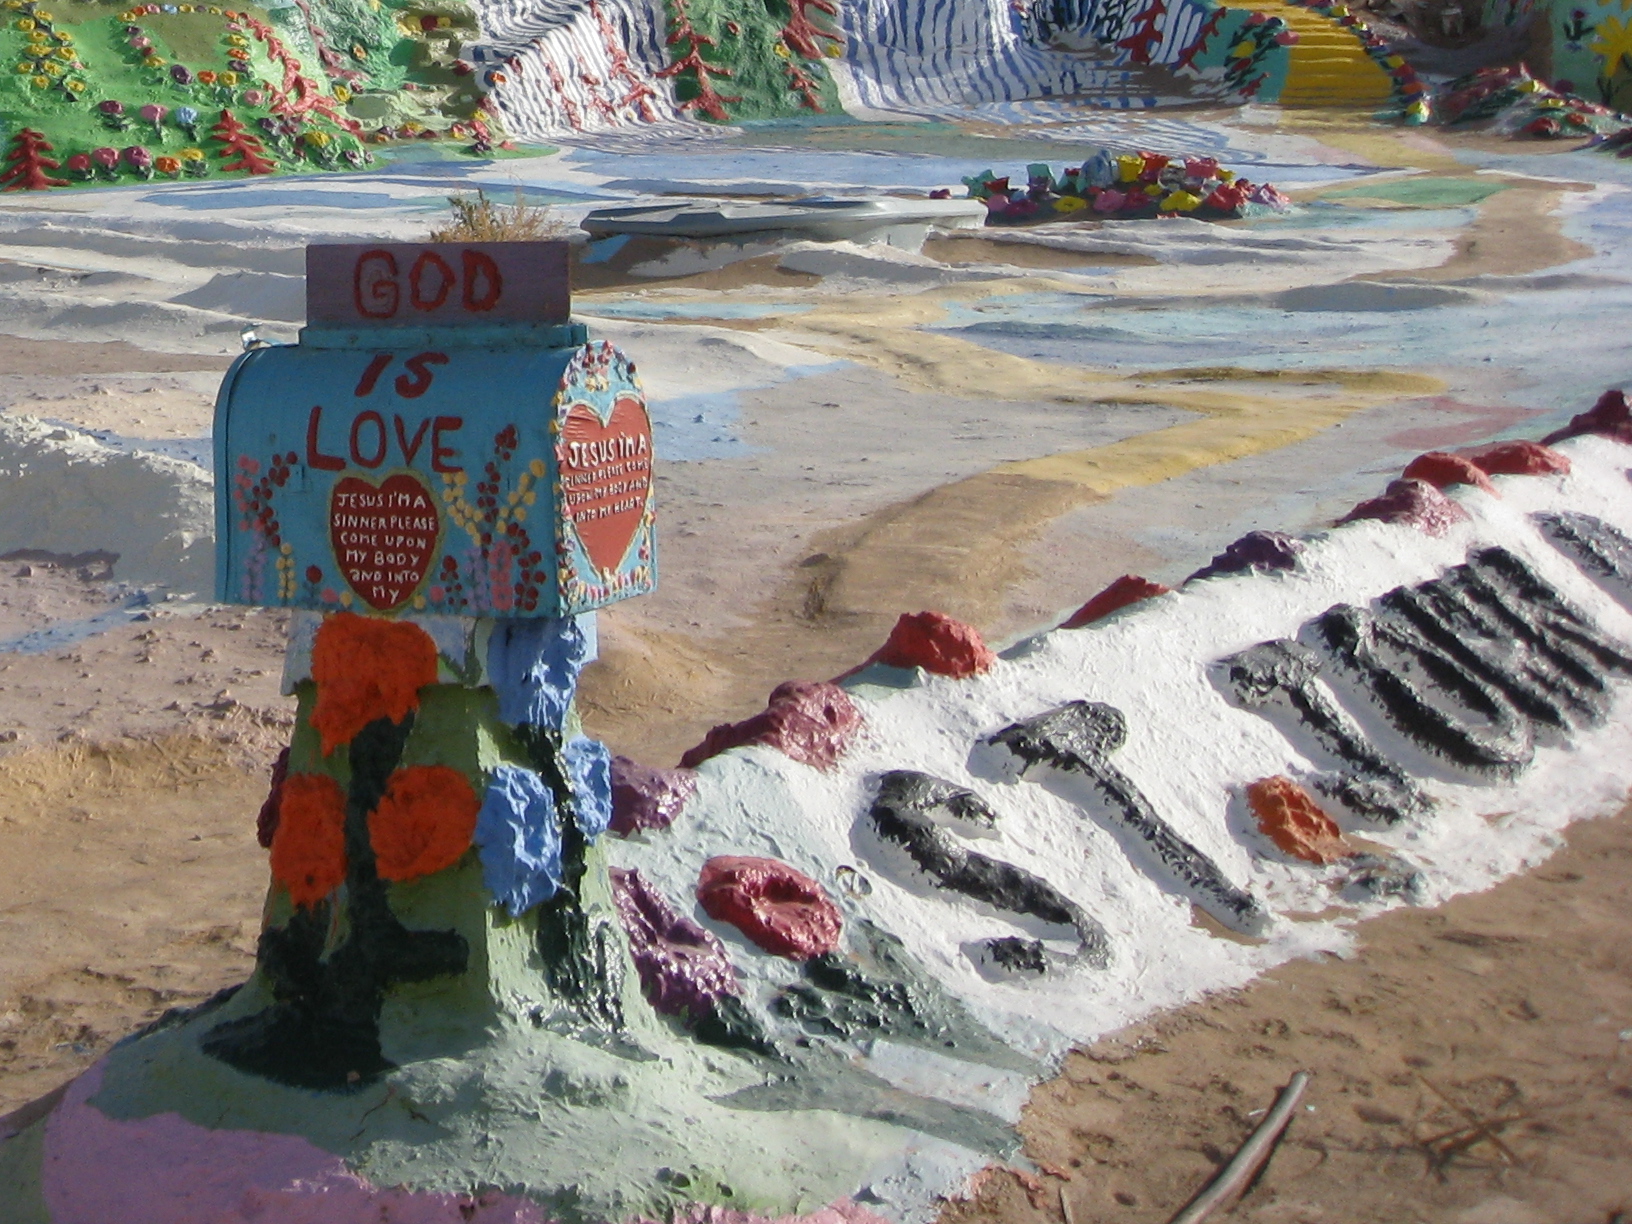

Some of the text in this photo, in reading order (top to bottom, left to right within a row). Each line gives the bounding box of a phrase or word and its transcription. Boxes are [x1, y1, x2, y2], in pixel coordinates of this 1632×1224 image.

[353, 249, 504, 319] GOD
[354, 351, 451, 400] IS
[305, 405, 464, 475] LOVE
[568, 431, 647, 468] JESUS I'M A
[565, 457, 649, 489] SINNER PLEASE COME
[337, 490, 427, 509] JESUS I'M A
[568, 475, 649, 506] UPON MY BODY AND
[333, 513, 436, 531] SINNER PLEASE
[576, 508, 597, 523] INTO
[598, 506, 611, 519] MY
[340, 531, 427, 550] COME UPON
[345, 548, 420, 567] MY BODY
[388, 569, 420, 584] INTO
[372, 584, 400, 605] MY
